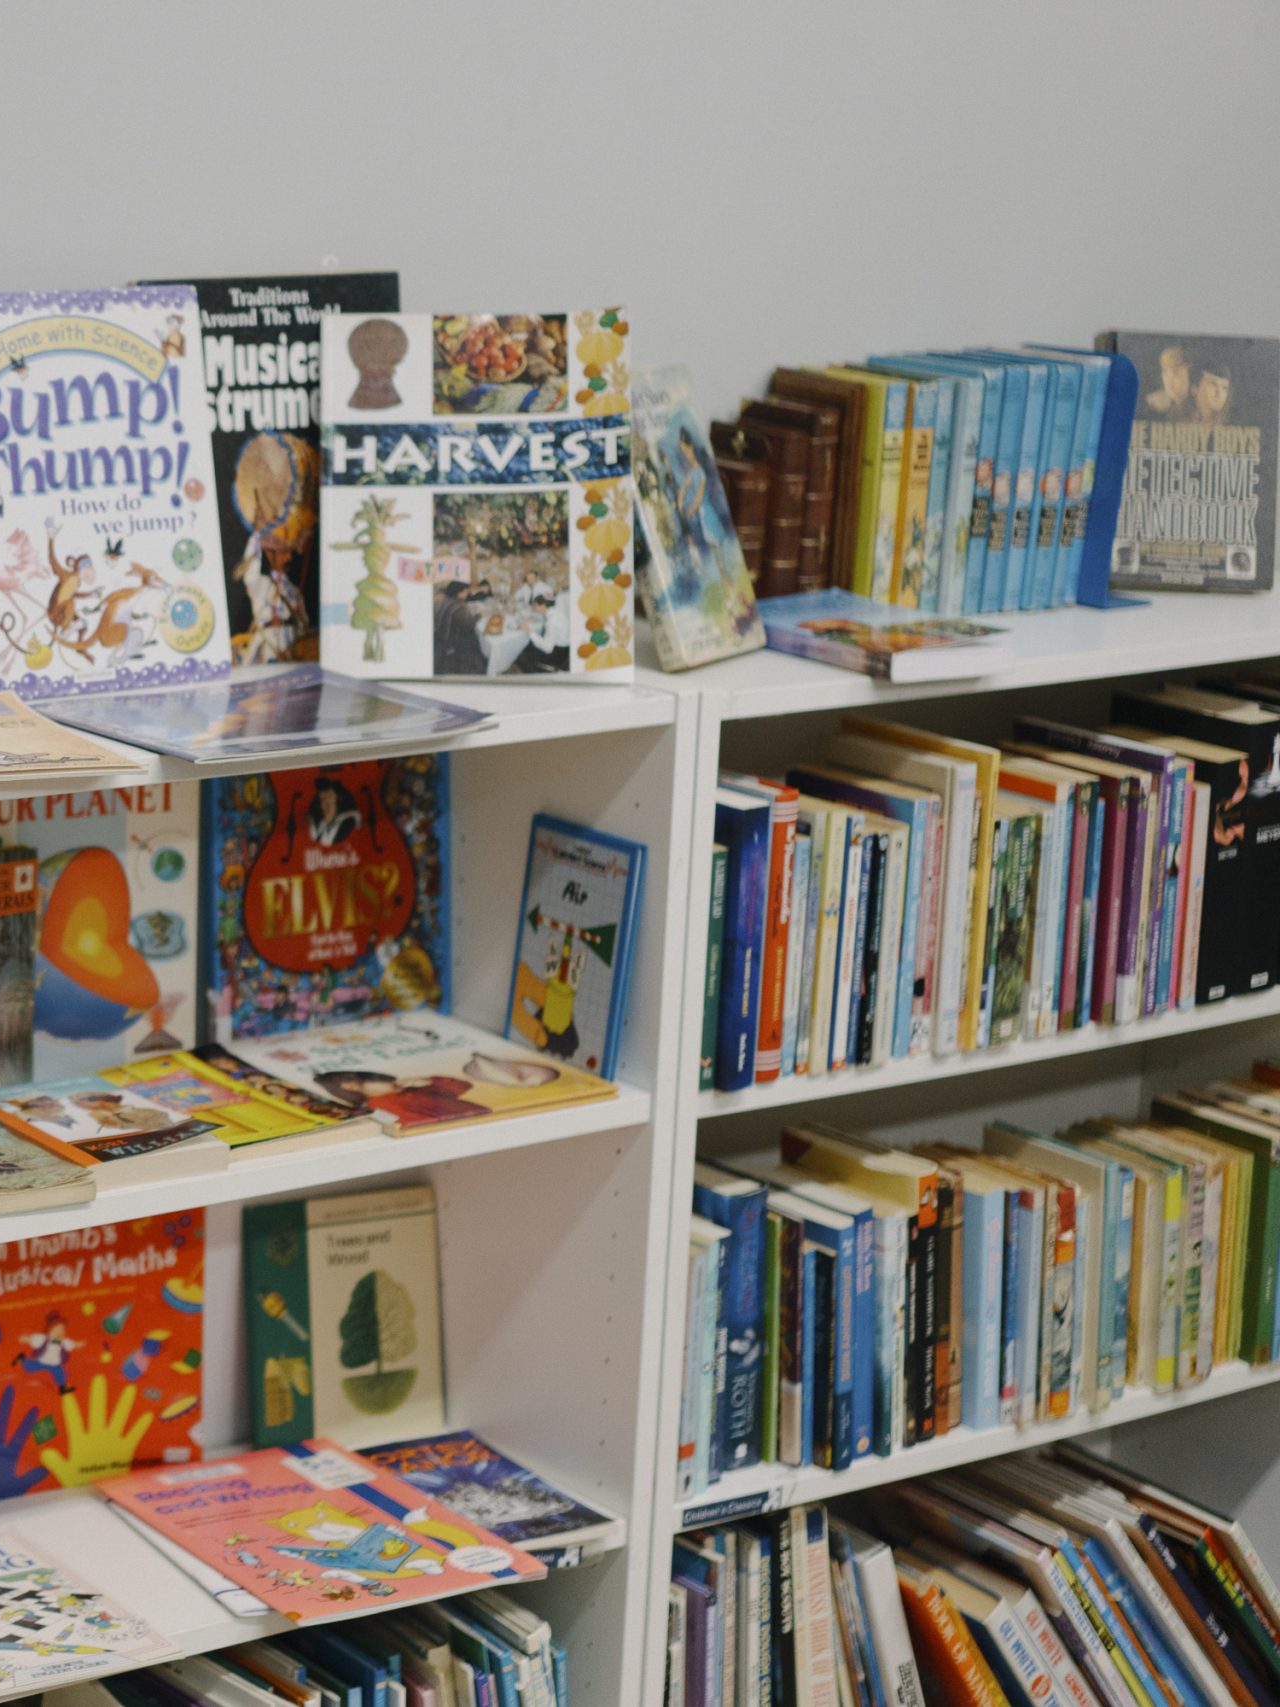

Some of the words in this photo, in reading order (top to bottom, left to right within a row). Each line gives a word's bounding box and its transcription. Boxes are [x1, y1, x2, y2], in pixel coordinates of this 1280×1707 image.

[228, 286, 310, 307] Traditions
[201, 309, 258, 328] Around
[261, 307, 292, 325] The
[46, 323, 86, 344] with
[91, 326, 160, 372] Science
[333, 426, 629, 474] HARVEST
[1214, 426, 1261, 454] BOYS
[60, 497, 110, 516] How
[115, 494, 142, 511] do
[93, 516, 126, 535] we
[45, 783, 174, 822] PLANET
[262, 861, 401, 940] ELVIS?
[561, 880, 588, 907] Air
[93, 1246, 178, 1284] Maths
[730, 1376, 748, 1439] ROTH
[134, 1478, 252, 1504] Reading
[156, 1496, 209, 1515] and
[219, 1481, 317, 1507] Writing
[1012, 1639, 1038, 1677] WHITE
[1038, 1628, 1064, 1667] WHITE
